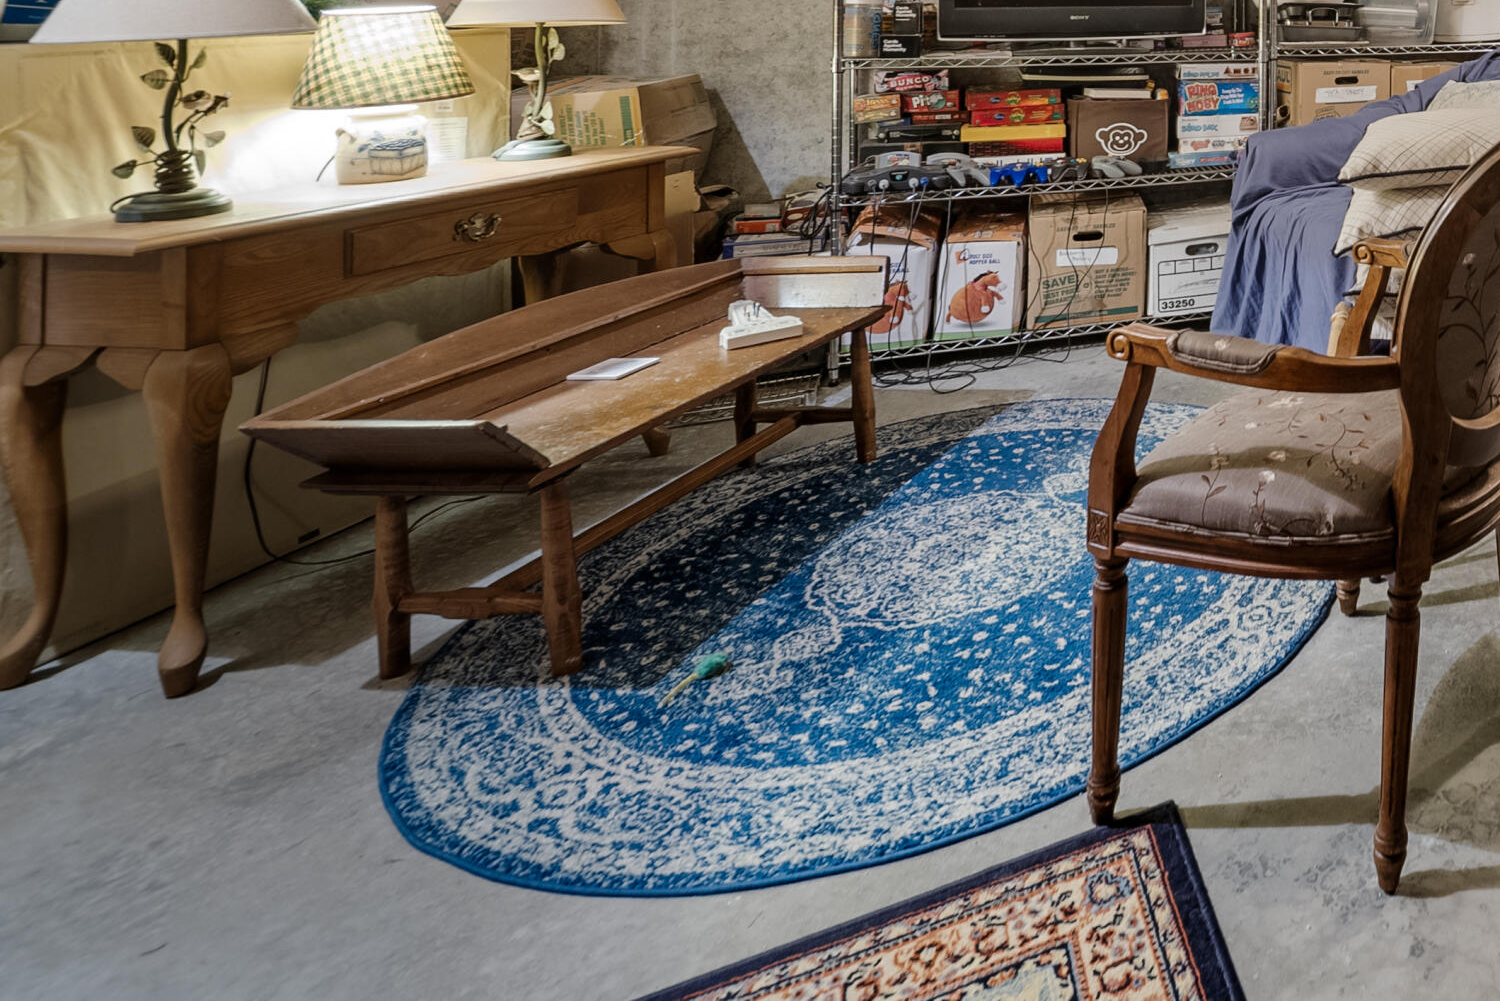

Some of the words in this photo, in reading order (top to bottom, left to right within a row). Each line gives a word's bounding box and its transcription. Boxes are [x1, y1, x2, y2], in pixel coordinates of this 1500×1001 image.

[886, 75, 930, 88] BUNCO
[1186, 83, 1218, 97] RING
[1042, 274, 1076, 290] SAVE
[1161, 298, 1196, 311] 33250
